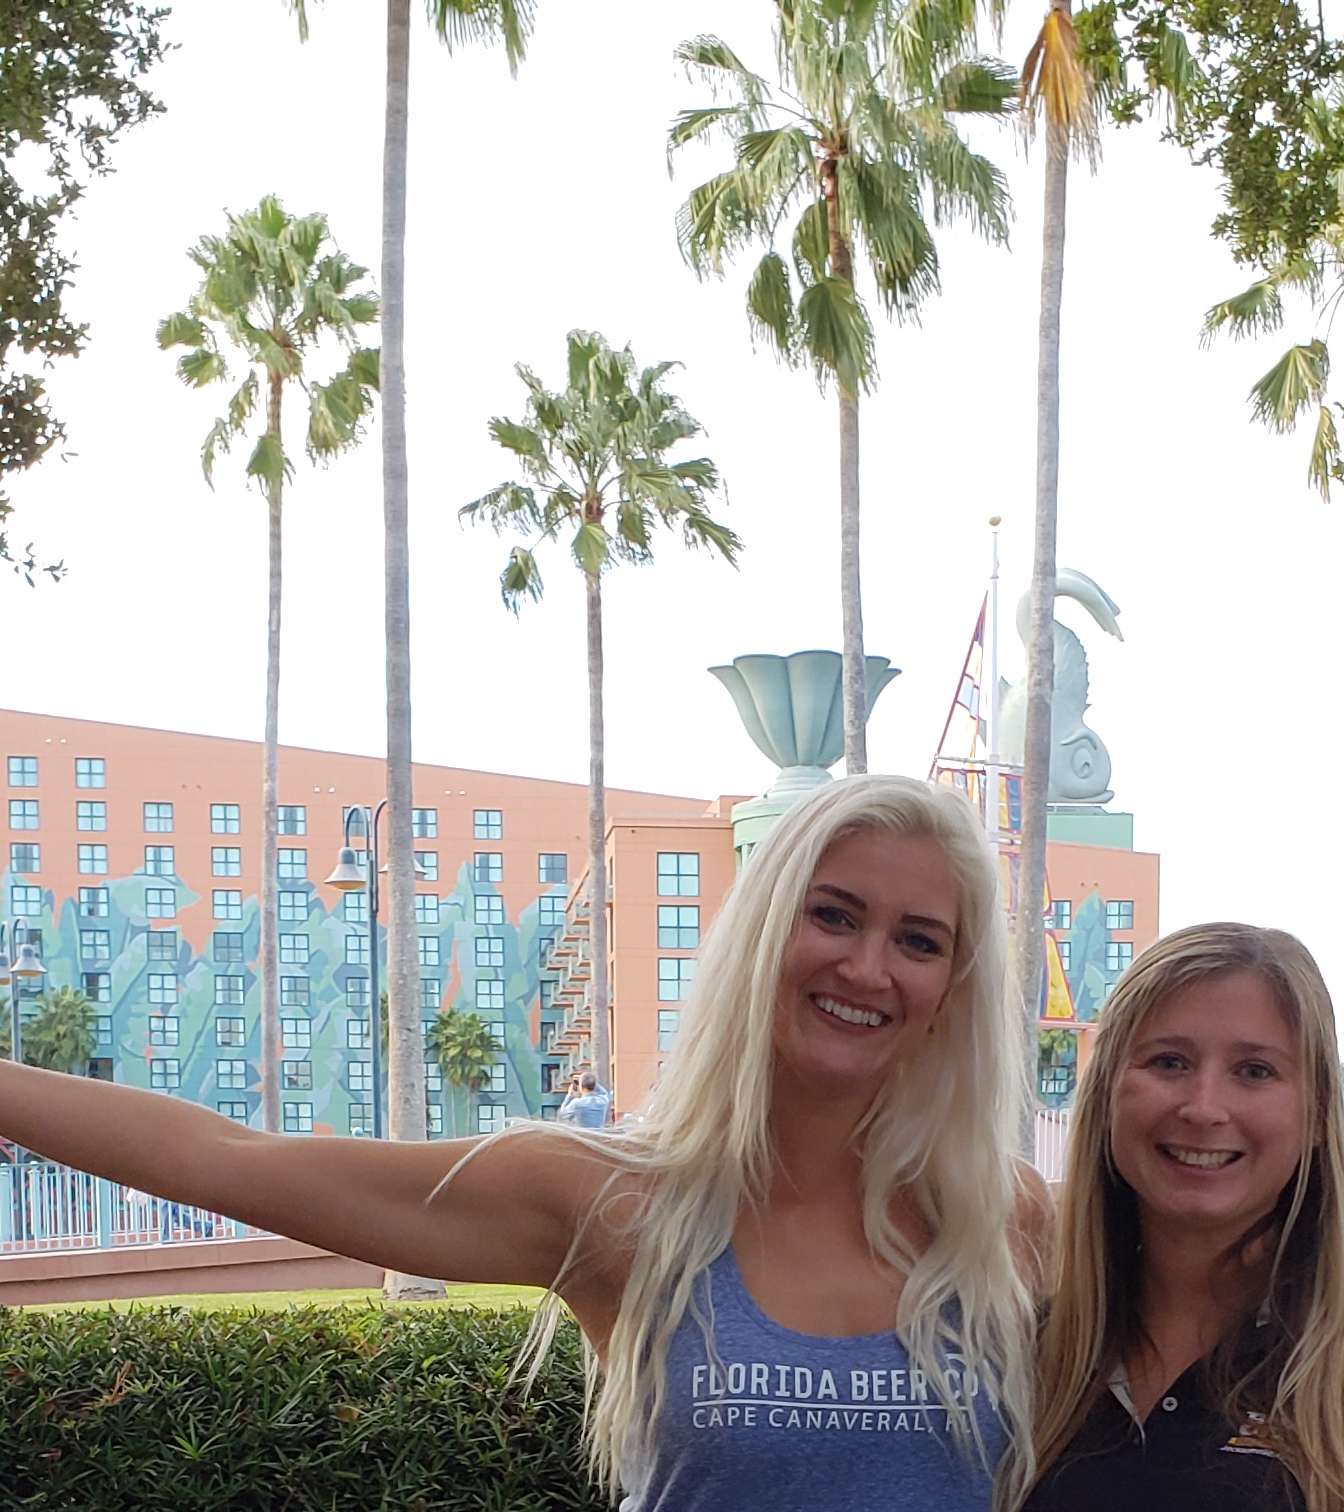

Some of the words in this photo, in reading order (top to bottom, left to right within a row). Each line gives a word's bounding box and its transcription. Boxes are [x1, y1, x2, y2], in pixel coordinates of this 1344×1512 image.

[692, 1362, 838, 1400] FLORIDA
[851, 1369, 928, 1401] BEER
[692, 1406, 757, 1429] CAPE
[768, 1408, 934, 1433] CANAVERAL,
